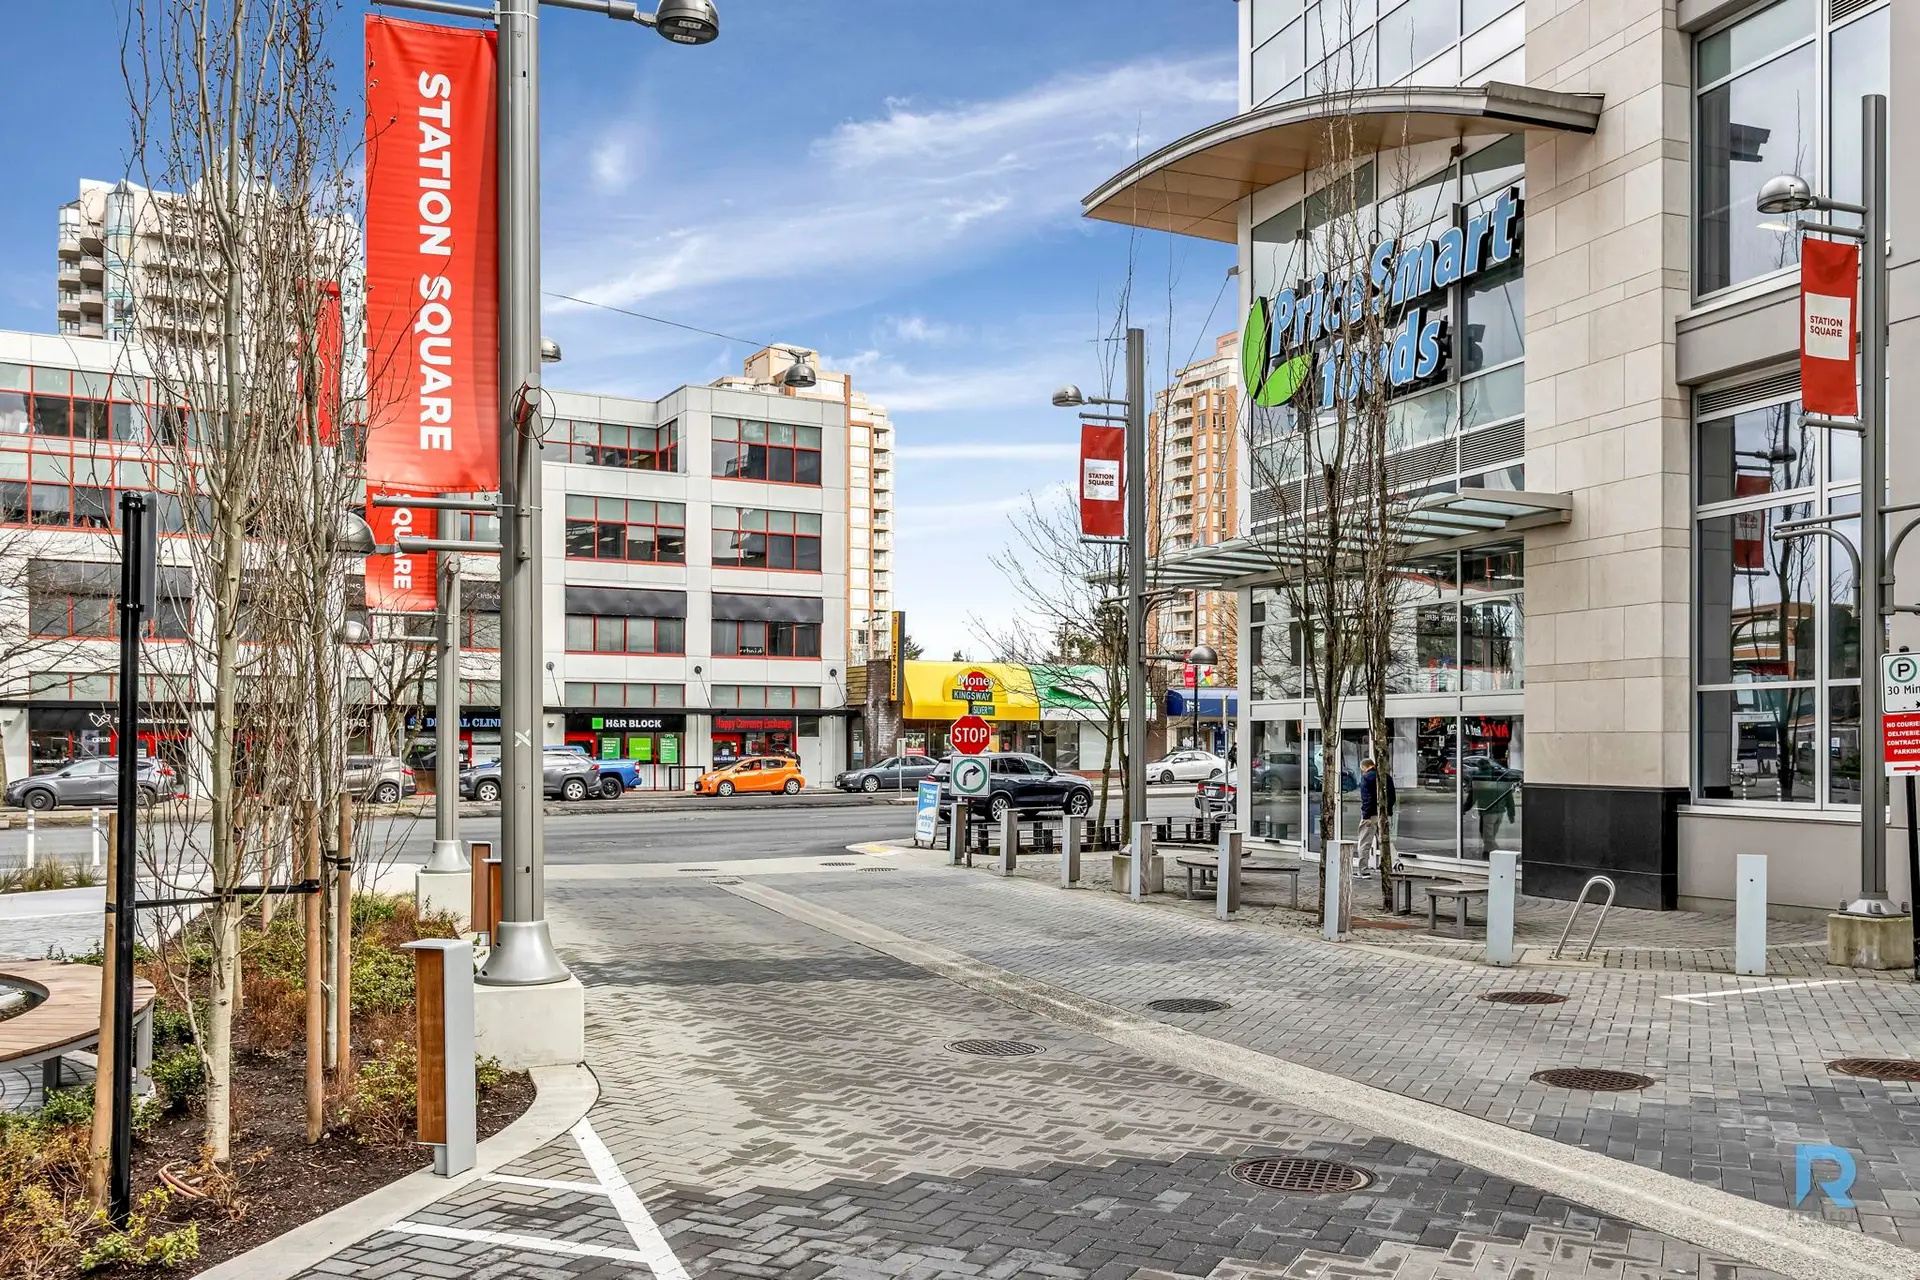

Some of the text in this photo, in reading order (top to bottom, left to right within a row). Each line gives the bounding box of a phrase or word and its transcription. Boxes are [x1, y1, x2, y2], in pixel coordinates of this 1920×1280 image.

[414, 71, 452, 451] STATION SQUARE
[1810, 315, 1843, 327] STATION
[1810, 326, 1843, 337] SQUARE
[957, 674, 995, 689] Money
[953, 690, 991, 701] KINGSWAY
[1887, 686, 1900, 696] 30
[972, 705, 988, 714] SILVER
[605, 719, 662, 728] H&R BLOCK
[715, 717, 792, 731] Happy Currency Exchange
[954, 727, 988, 743] STOP
